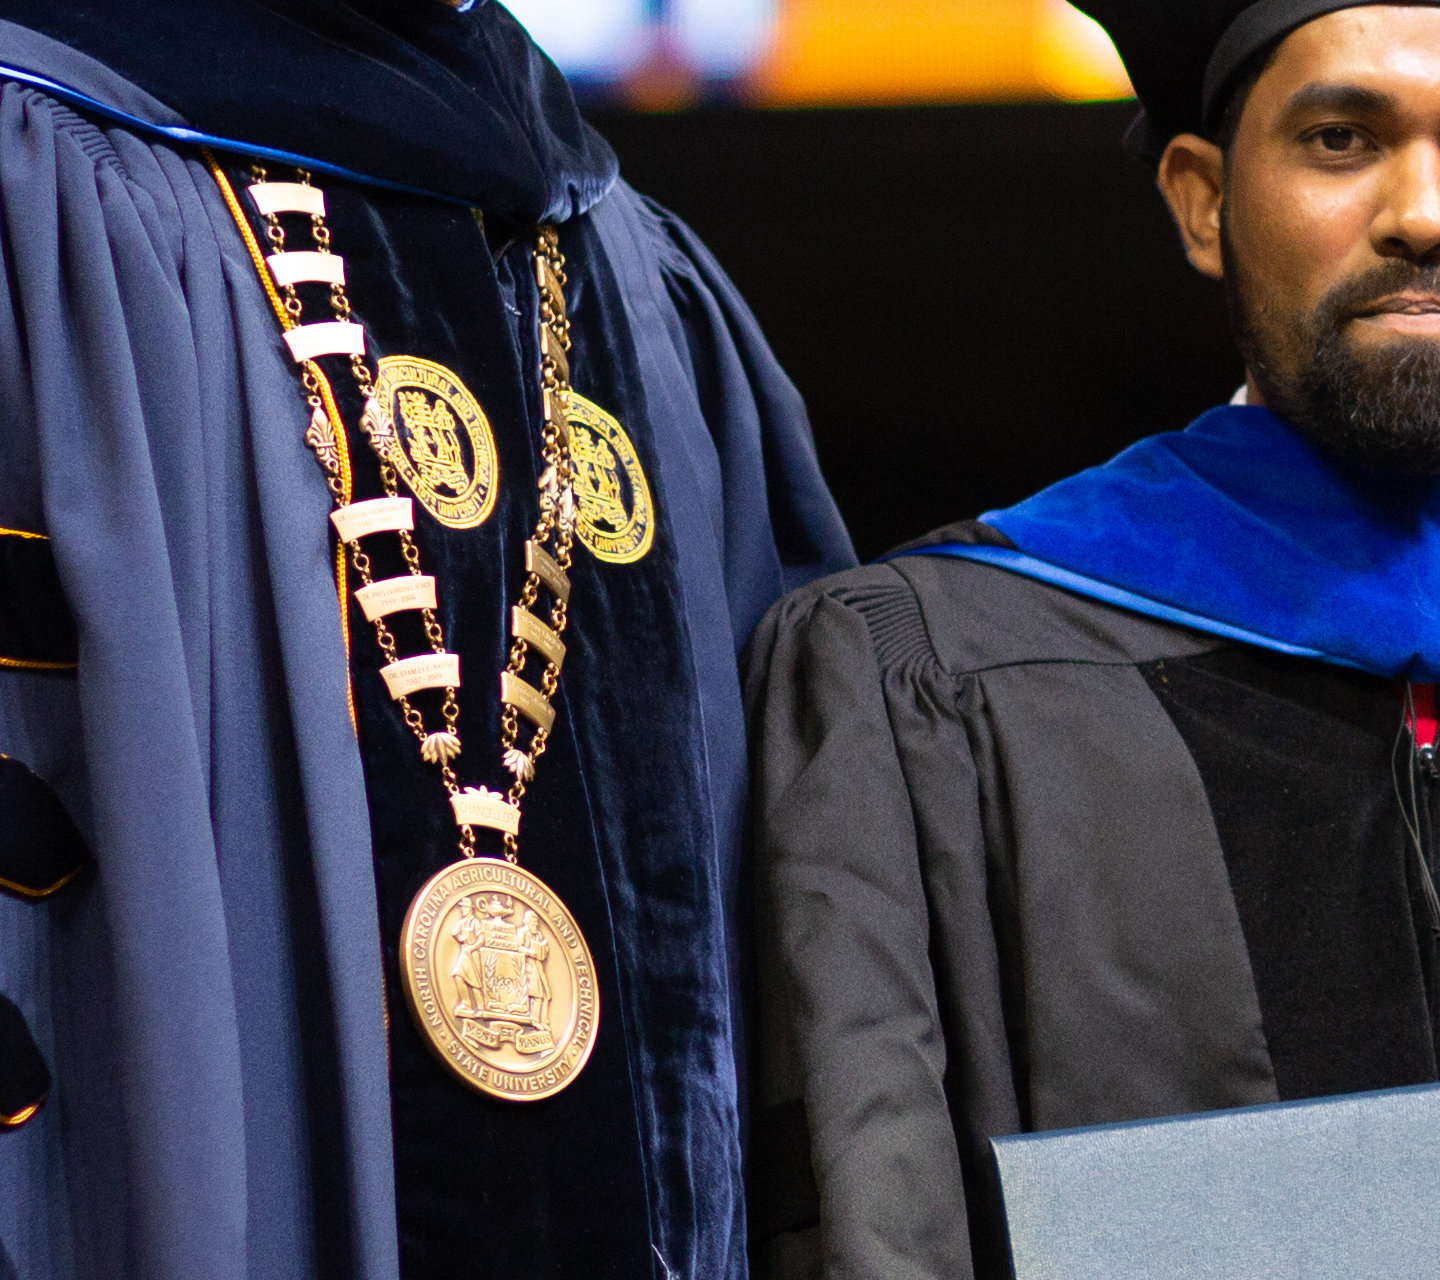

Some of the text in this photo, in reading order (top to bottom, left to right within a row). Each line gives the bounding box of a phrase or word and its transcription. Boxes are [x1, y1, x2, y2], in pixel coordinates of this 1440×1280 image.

[459, 801, 516, 825] CHANCELLOR
[413, 866, 593, 1049] NORTH CAROLINA AGRICULTURAL AND TECHNICAL
[447, 1040, 573, 1092] STATE UNIVERSITY
